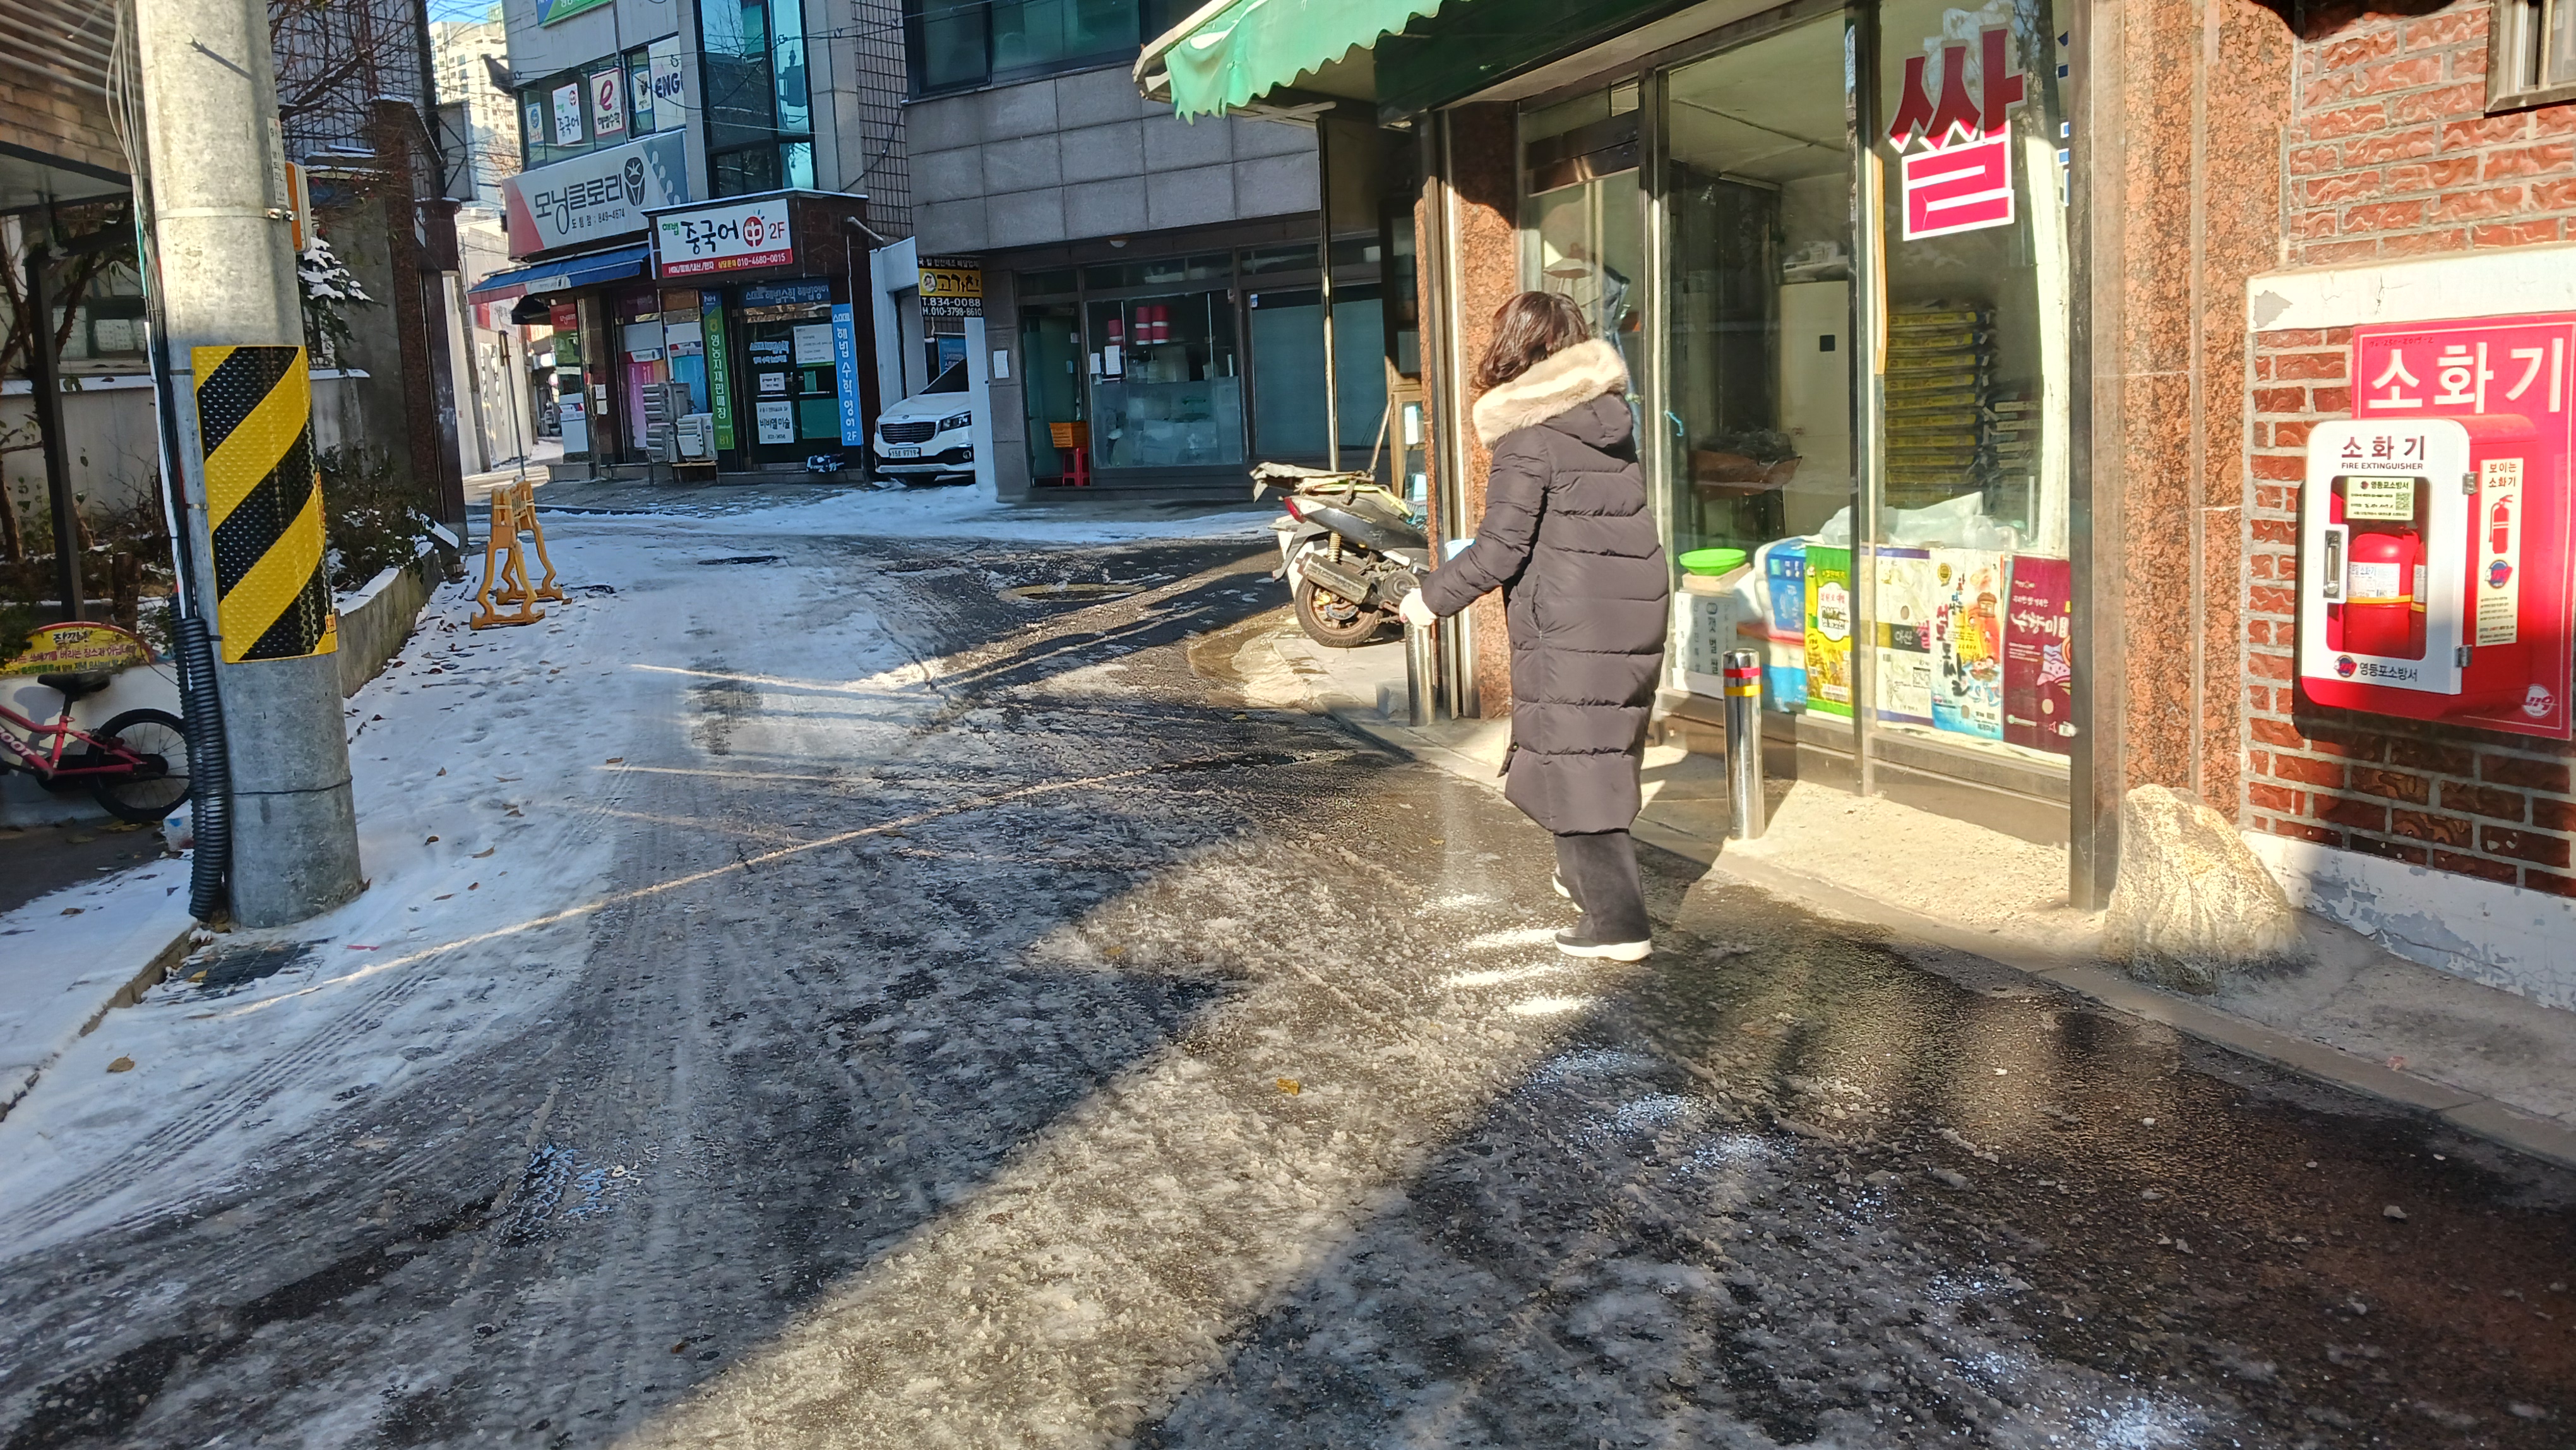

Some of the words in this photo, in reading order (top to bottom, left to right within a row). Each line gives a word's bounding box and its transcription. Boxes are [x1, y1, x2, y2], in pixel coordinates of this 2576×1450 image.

[556, 115, 580, 136] 중국어
[1883, 23, 2028, 243] 쌀
[534, 174, 624, 235] 모닝글로리
[598, 208, 626, 224] 849-4674
[680, 219, 740, 255] 중국어
[768, 222, 785, 239] 2F
[737, 252, 786, 267] 010-4680-0015
[922, 297, 981, 307] T.834-0088
[2368, 337, 2564, 414] 소화기
[847, 431, 857, 441] 2F
[2341, 435, 2424, 460] 소화기
[2489, 462, 2517, 474] 보이는
[2371, 481, 2409, 490] 영등포소방서
[2488, 476, 2517, 488] 소화기
[60, 649, 82, 659] 버리는
[84, 647, 105, 658] 장소가
[2359, 662, 2418, 682] 영등포소방서
